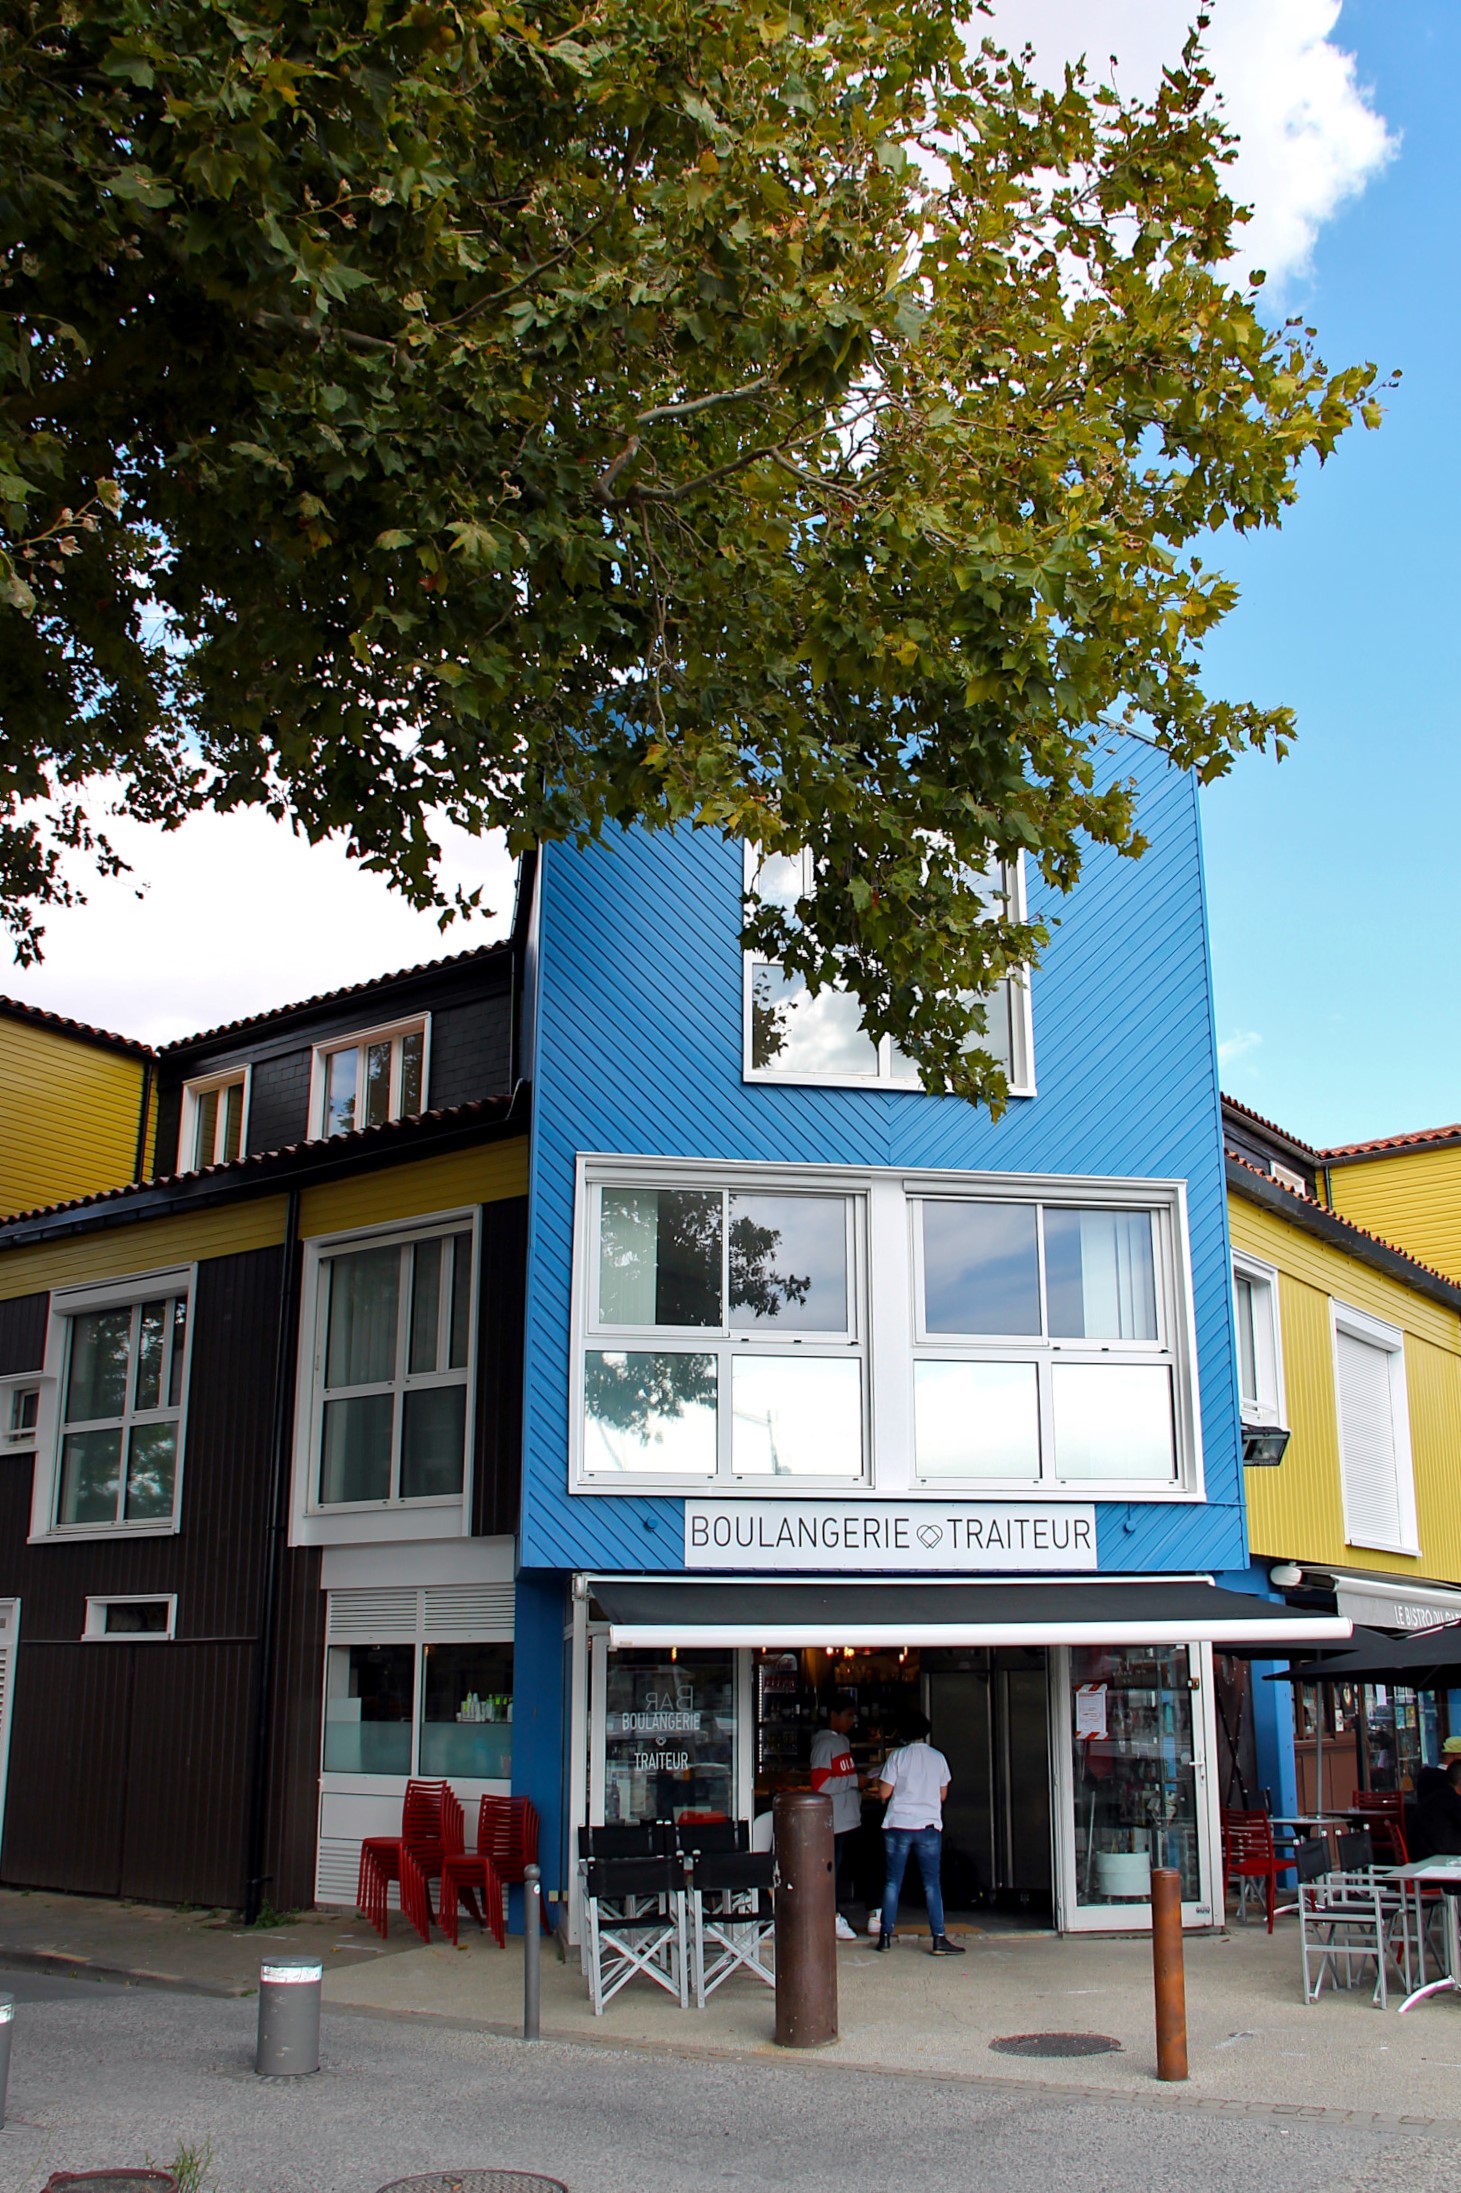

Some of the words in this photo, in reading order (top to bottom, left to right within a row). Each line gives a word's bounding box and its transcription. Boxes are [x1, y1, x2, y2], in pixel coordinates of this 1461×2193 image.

[691, 1515, 910, 1548] BOULANGERIE
[946, 1518, 1091, 1549] TRAITEUR
[1394, 1605, 1405, 1625] LE
[1404, 1606, 1432, 1627] BISTRO
[622, 1712, 701, 1730] BOULANGERIE
[634, 1752, 689, 1771] TRAITEUR
